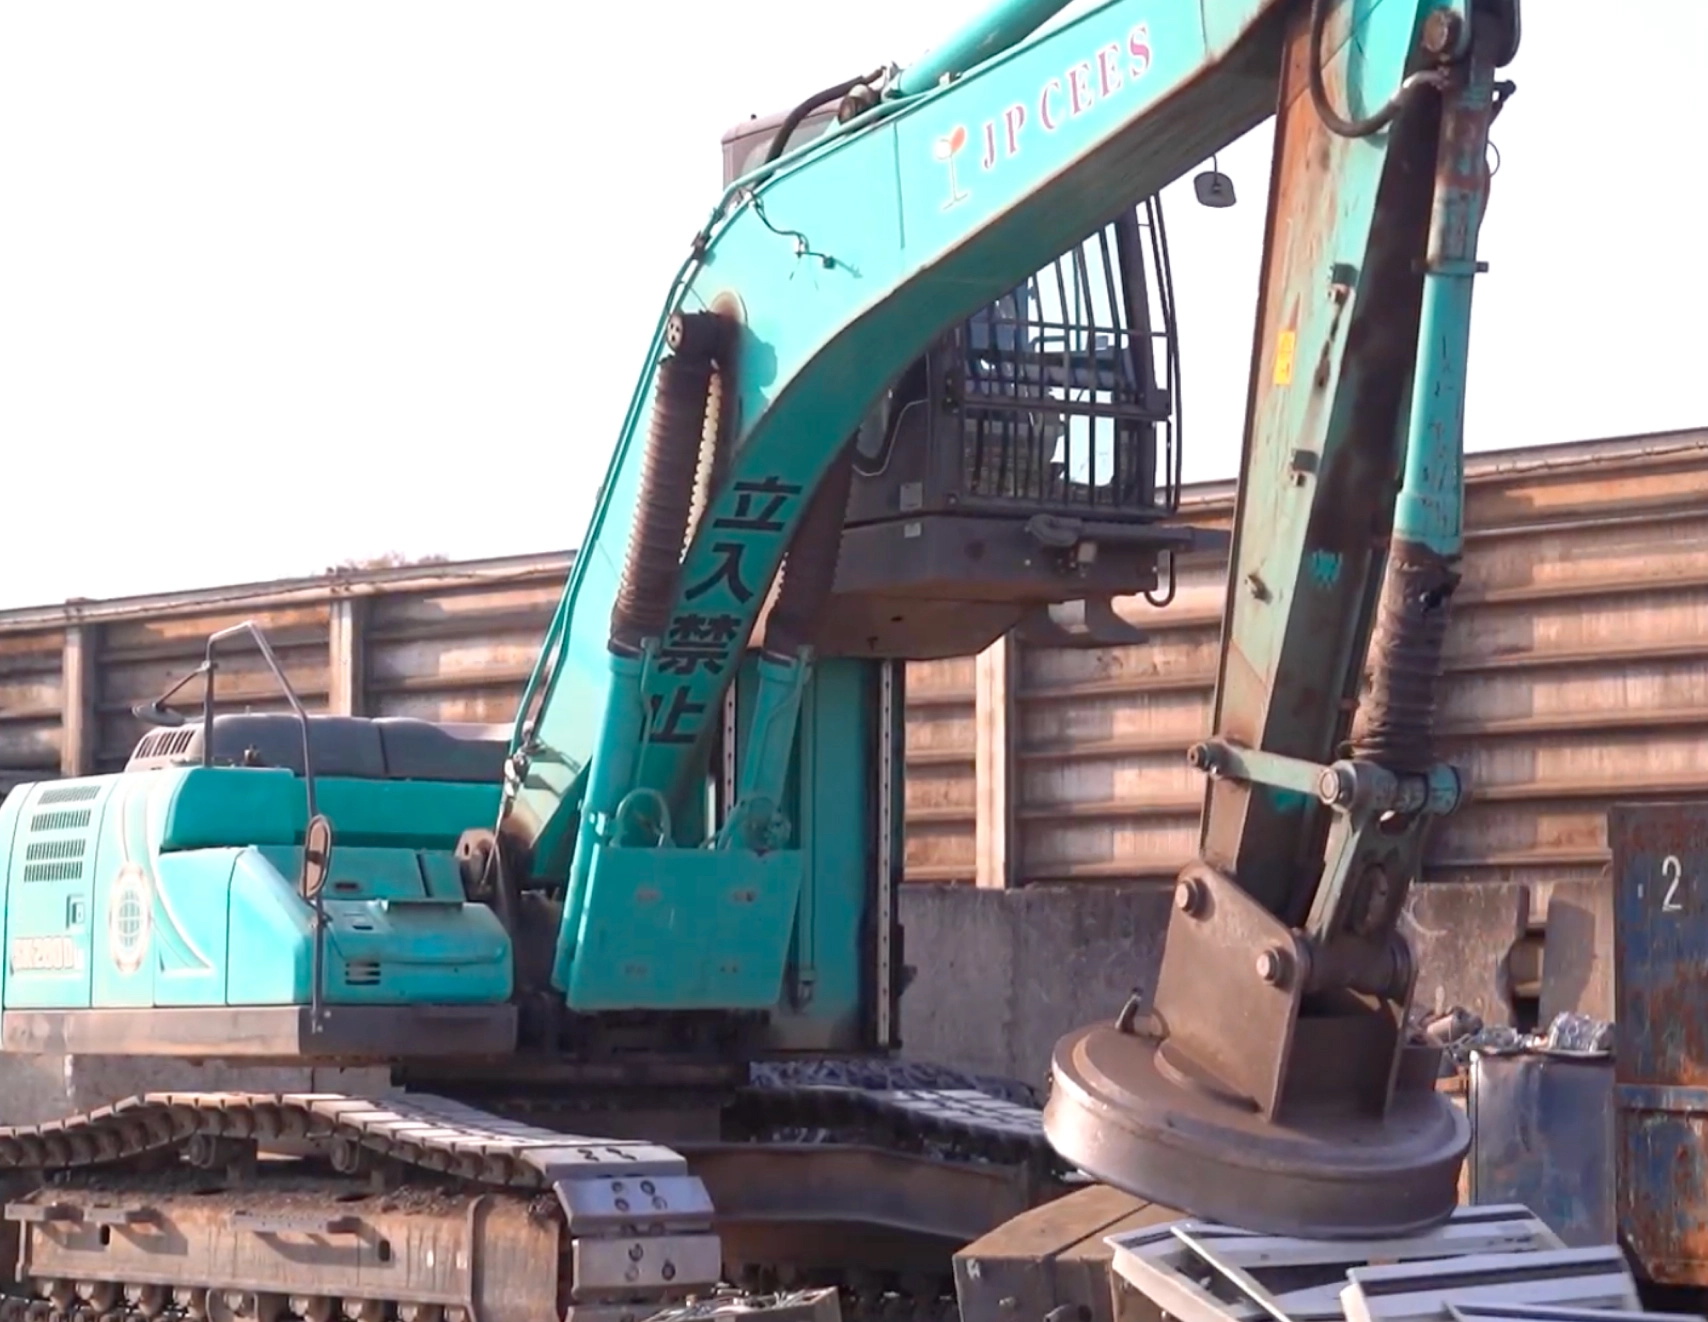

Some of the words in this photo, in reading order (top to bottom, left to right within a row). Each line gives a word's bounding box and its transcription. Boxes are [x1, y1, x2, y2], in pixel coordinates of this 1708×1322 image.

[1040, 26, 1151, 131] CEES
[639, 475, 803, 745] 立入禁止
[1661, 855, 1682, 912] 2
